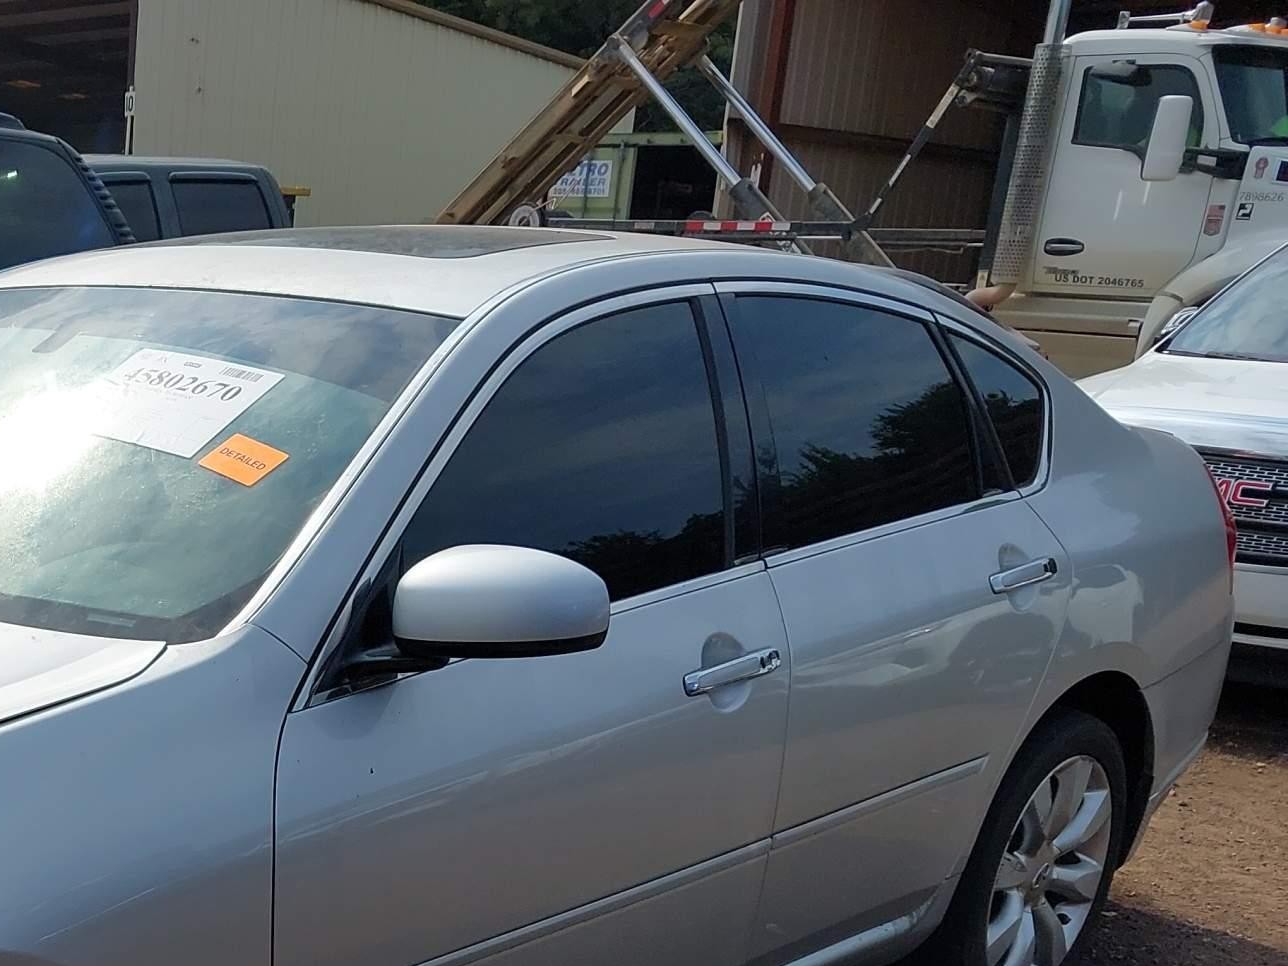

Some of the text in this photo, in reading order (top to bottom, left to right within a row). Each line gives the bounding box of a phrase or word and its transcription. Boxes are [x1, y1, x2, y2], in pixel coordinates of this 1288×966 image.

[1054, 274, 1145, 289] US DOT 2046765
[123, 367, 243, 402] 45802670
[219, 447, 266, 471] DETAILED
